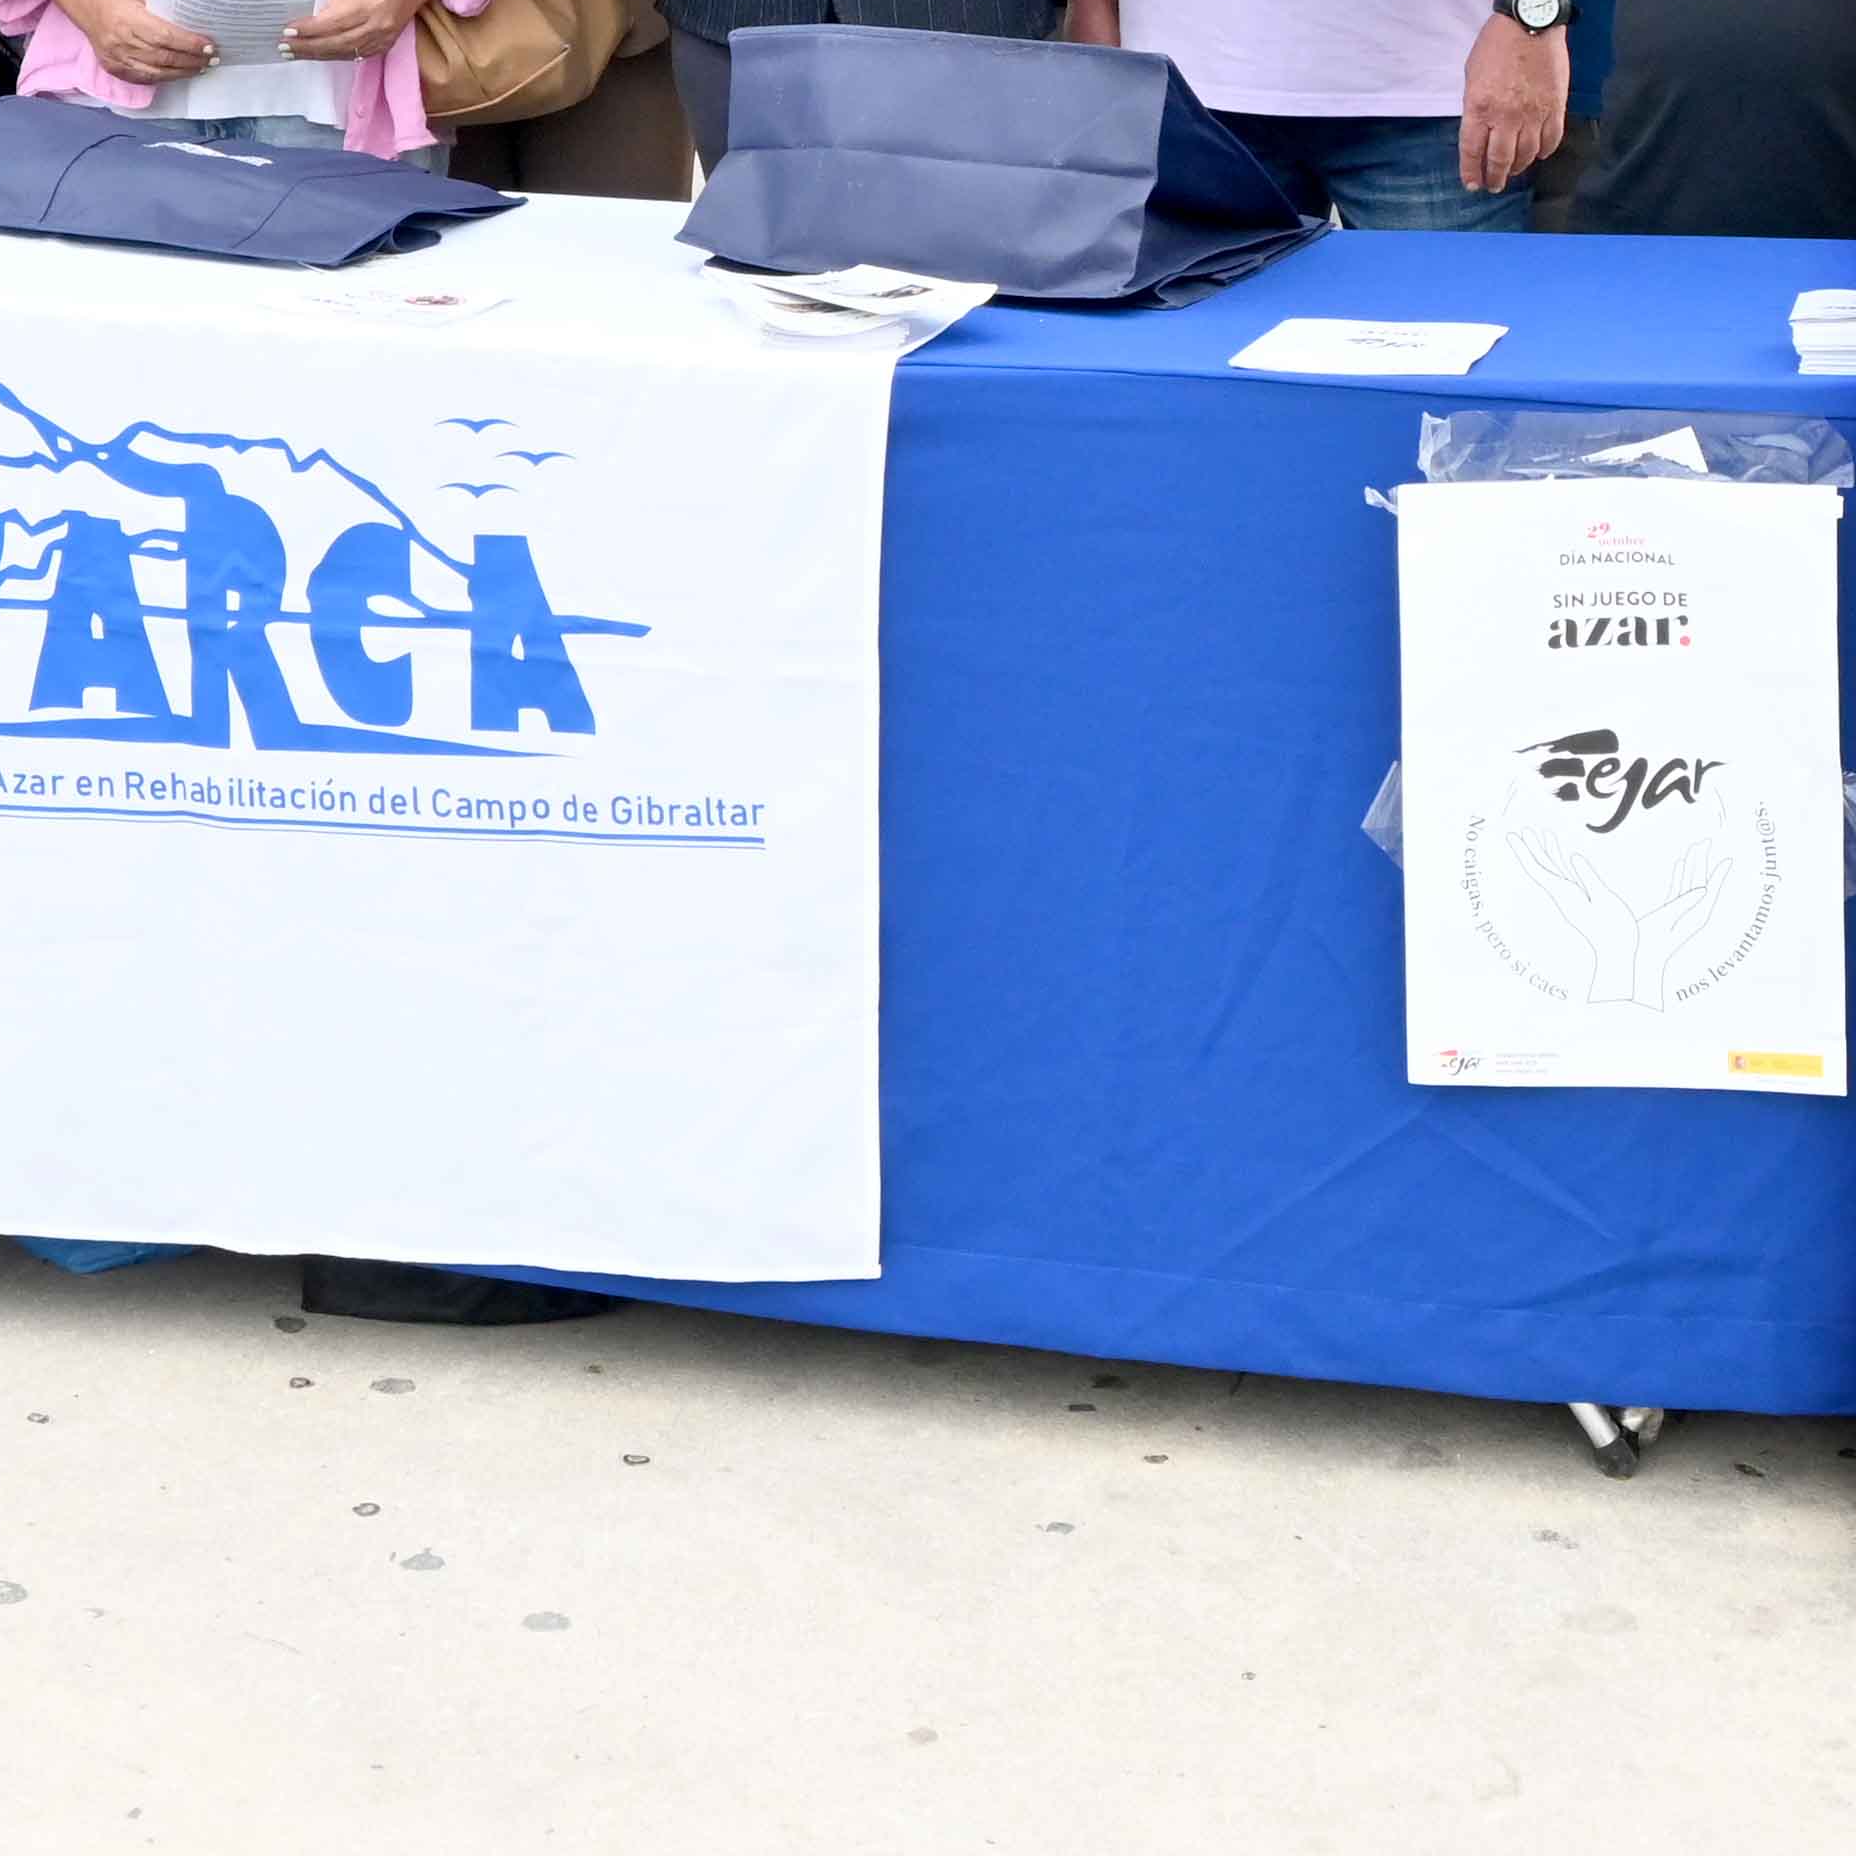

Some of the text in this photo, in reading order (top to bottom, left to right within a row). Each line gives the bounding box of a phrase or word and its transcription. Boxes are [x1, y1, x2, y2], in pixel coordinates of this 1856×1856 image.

[1587, 522, 1611, 538] 29
[1598, 535, 1646, 546] octubre
[1559, 550, 1676, 566] DÍA NACIONAL
[1553, 591, 1689, 608] SIN JUEGO DE
[75, 775, 115, 799] en
[125, 770, 357, 812] Rehabilitación
[368, 785, 420, 816] del
[431, 787, 551, 827] Campo
[562, 794, 598, 824] de
[611, 795, 766, 827] Gibraltar
[1465, 814, 1486, 842] No
[1460, 847, 1483, 918] caigas,
[1475, 919, 1513, 961] pero
[1675, 977, 1710, 1002] nos
[1707, 883, 1775, 983] levantamos
[1528, 971, 1569, 1002] caes
